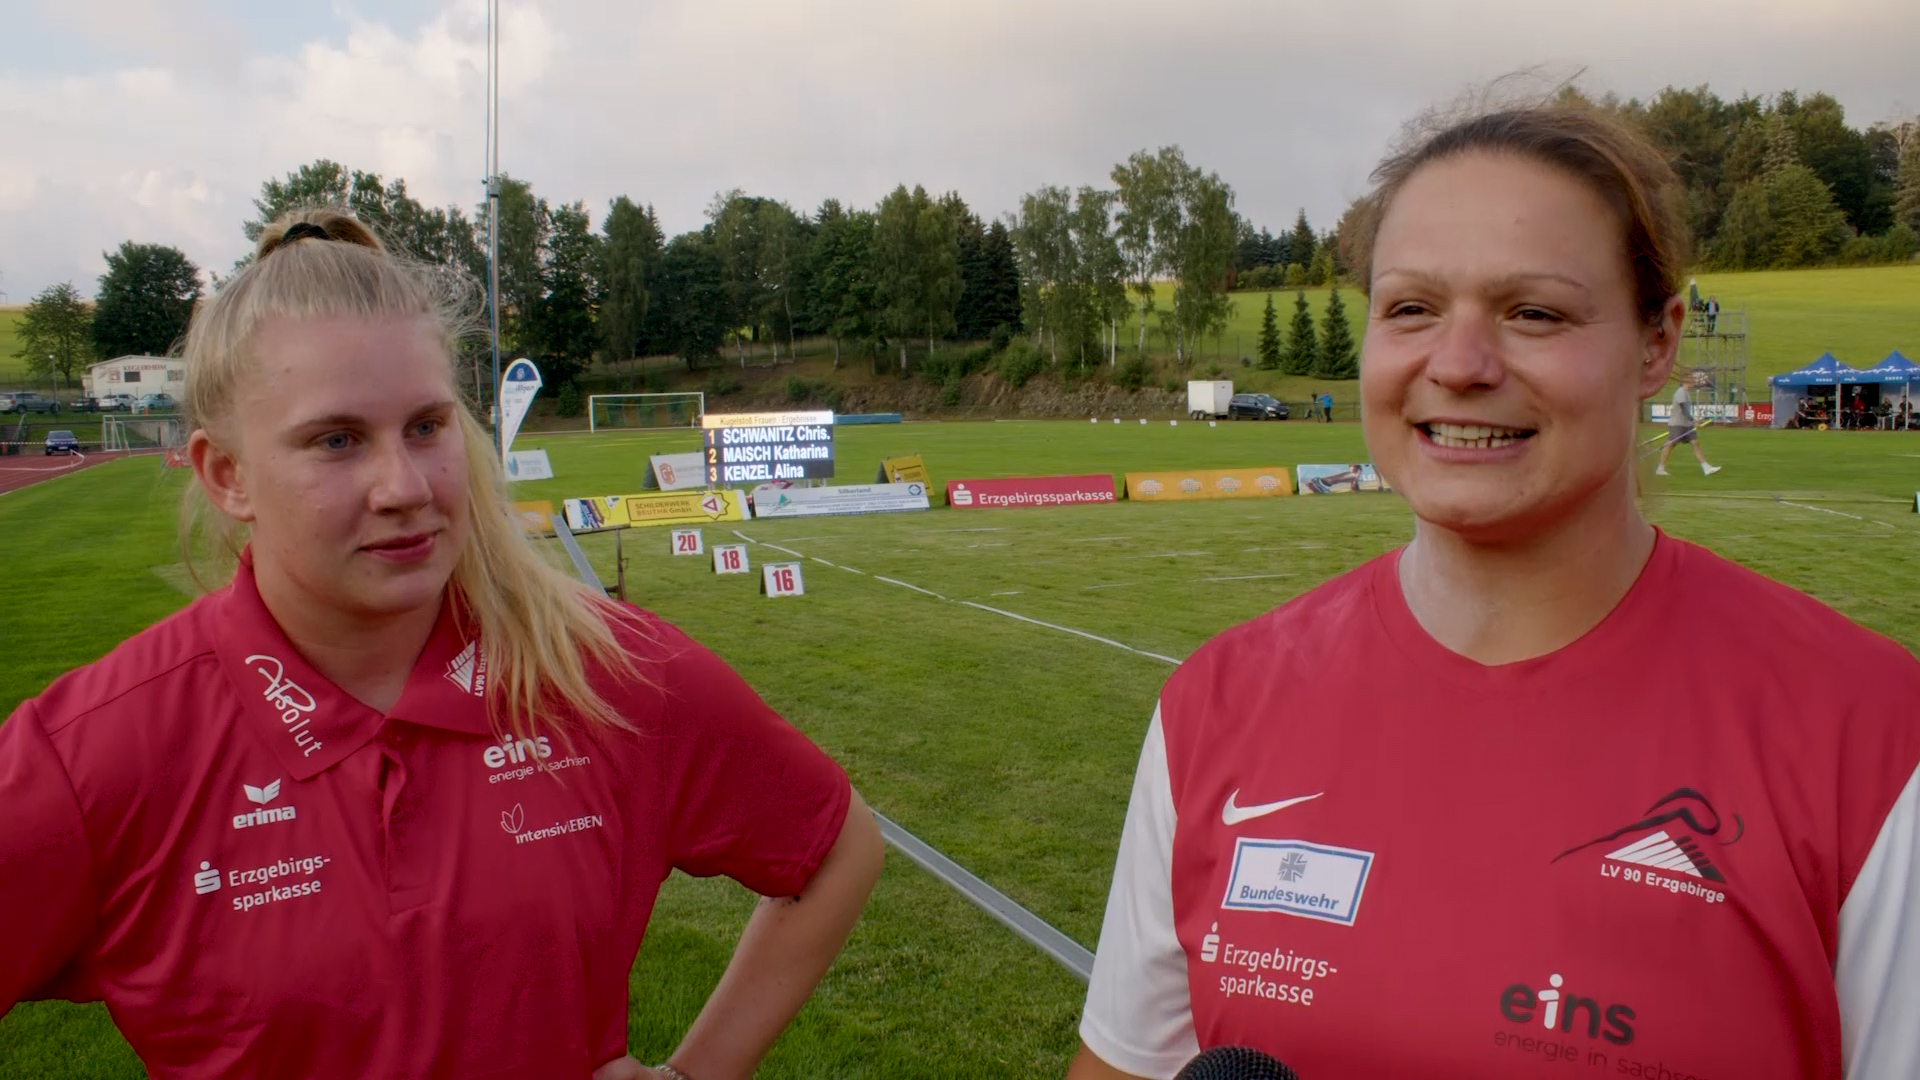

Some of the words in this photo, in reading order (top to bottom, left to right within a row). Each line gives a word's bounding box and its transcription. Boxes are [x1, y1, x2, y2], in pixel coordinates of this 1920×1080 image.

[709, 429, 715, 444] 1
[723, 427, 795, 444] SCHWANITZ
[796, 426, 831, 441] Chris.
[709, 448, 717, 463] 2
[723, 447, 771, 463] MAISCH
[774, 444, 829, 460] Katharina
[710, 467, 718, 482] 3
[724, 465, 773, 481] KENZEL
[774, 463, 804, 479] Alina
[635, 501, 690, 509] SCHILDERWERK
[979, 490, 1114, 506] Erzgebirgssparkasse
[678, 534, 697, 552] 20
[721, 550, 740, 570] 18
[772, 569, 795, 592] 16
[483, 733, 552, 768] eins
[489, 764, 534, 784] energie
[233, 806, 296, 829] erima
[229, 855, 331, 887] Erzgebirgs-
[1600, 863, 1620, 878] LV
[1624, 867, 1641, 882] 90
[1645, 872, 1725, 903] Erzgebirge
[233, 880, 321, 912] sparkasse
[1239, 885, 1340, 910] Bundeswehr
[1223, 944, 1338, 980] Erzgebirgs-
[1219, 975, 1314, 1006] sparkasse
[1501, 973, 1636, 1045] eins
[1494, 1031, 1578, 1062] energie
[1588, 1048, 1607, 1067] in
